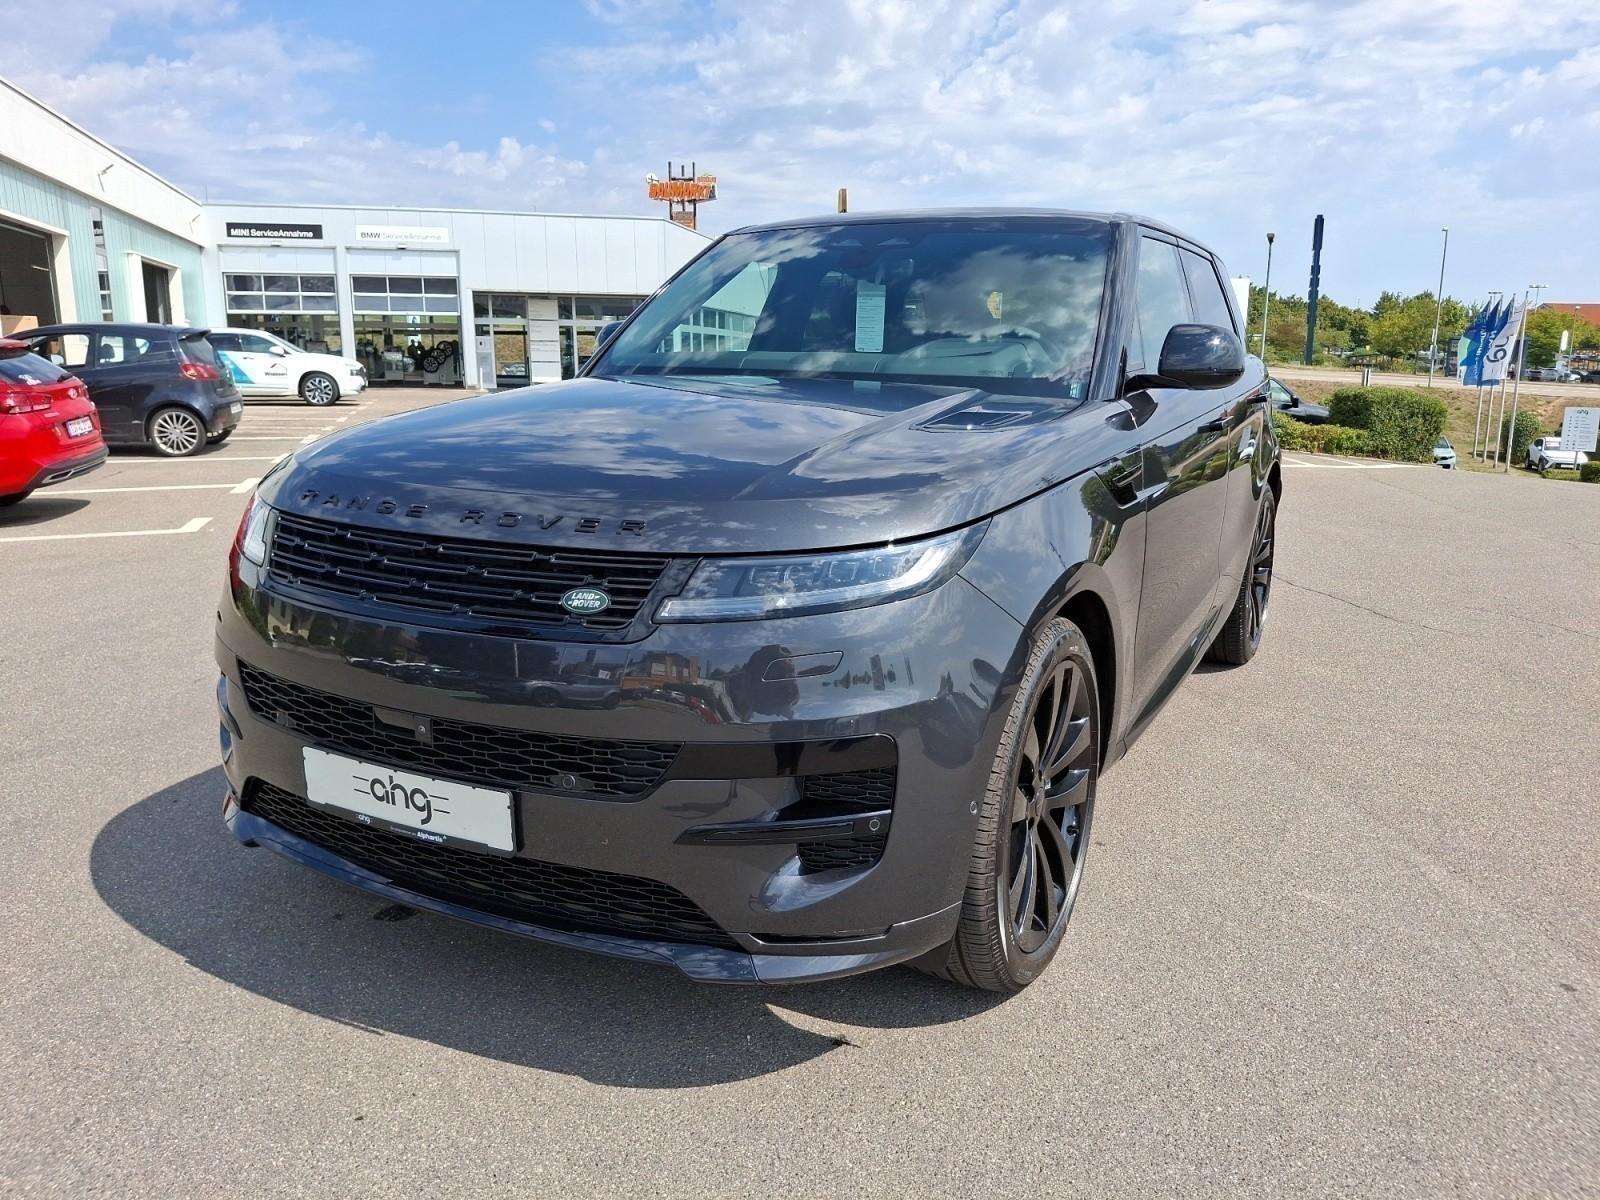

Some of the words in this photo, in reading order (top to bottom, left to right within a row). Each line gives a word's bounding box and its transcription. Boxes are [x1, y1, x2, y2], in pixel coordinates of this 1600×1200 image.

[230, 228, 249, 237] MINI
[250, 228, 314, 238] ServiceAnnahme
[360, 231, 381, 239] BMW
[301, 489, 429, 519] RANGE
[459, 509, 647, 537] ROVER
[571, 592, 595, 600] LAND
[571, 600, 601, 608] ROVER
